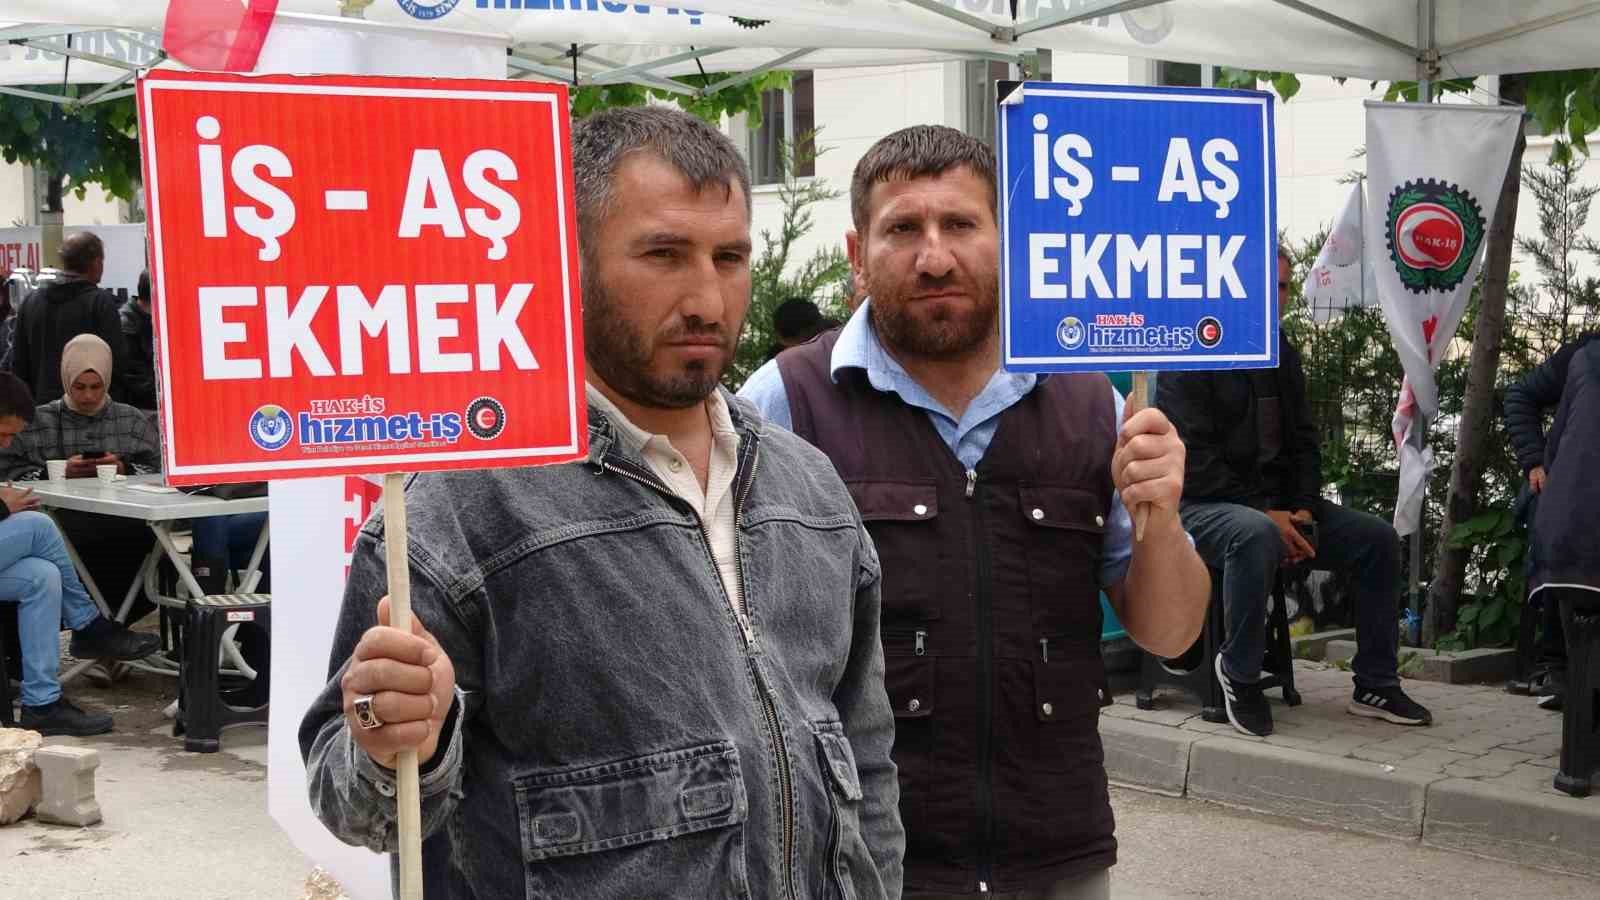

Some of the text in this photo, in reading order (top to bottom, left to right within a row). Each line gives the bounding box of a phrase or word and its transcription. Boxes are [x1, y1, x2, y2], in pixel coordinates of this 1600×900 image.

[196, 115, 521, 262] İŞ - AŞ
[1033, 113, 1240, 219] İŞ - AŞ
[1029, 233, 1248, 299] EKMEK
[198, 283, 540, 381] EKMEK
[1088, 323, 1194, 350] hizmet-iş
[299, 411, 462, 444] hizmet-iş
